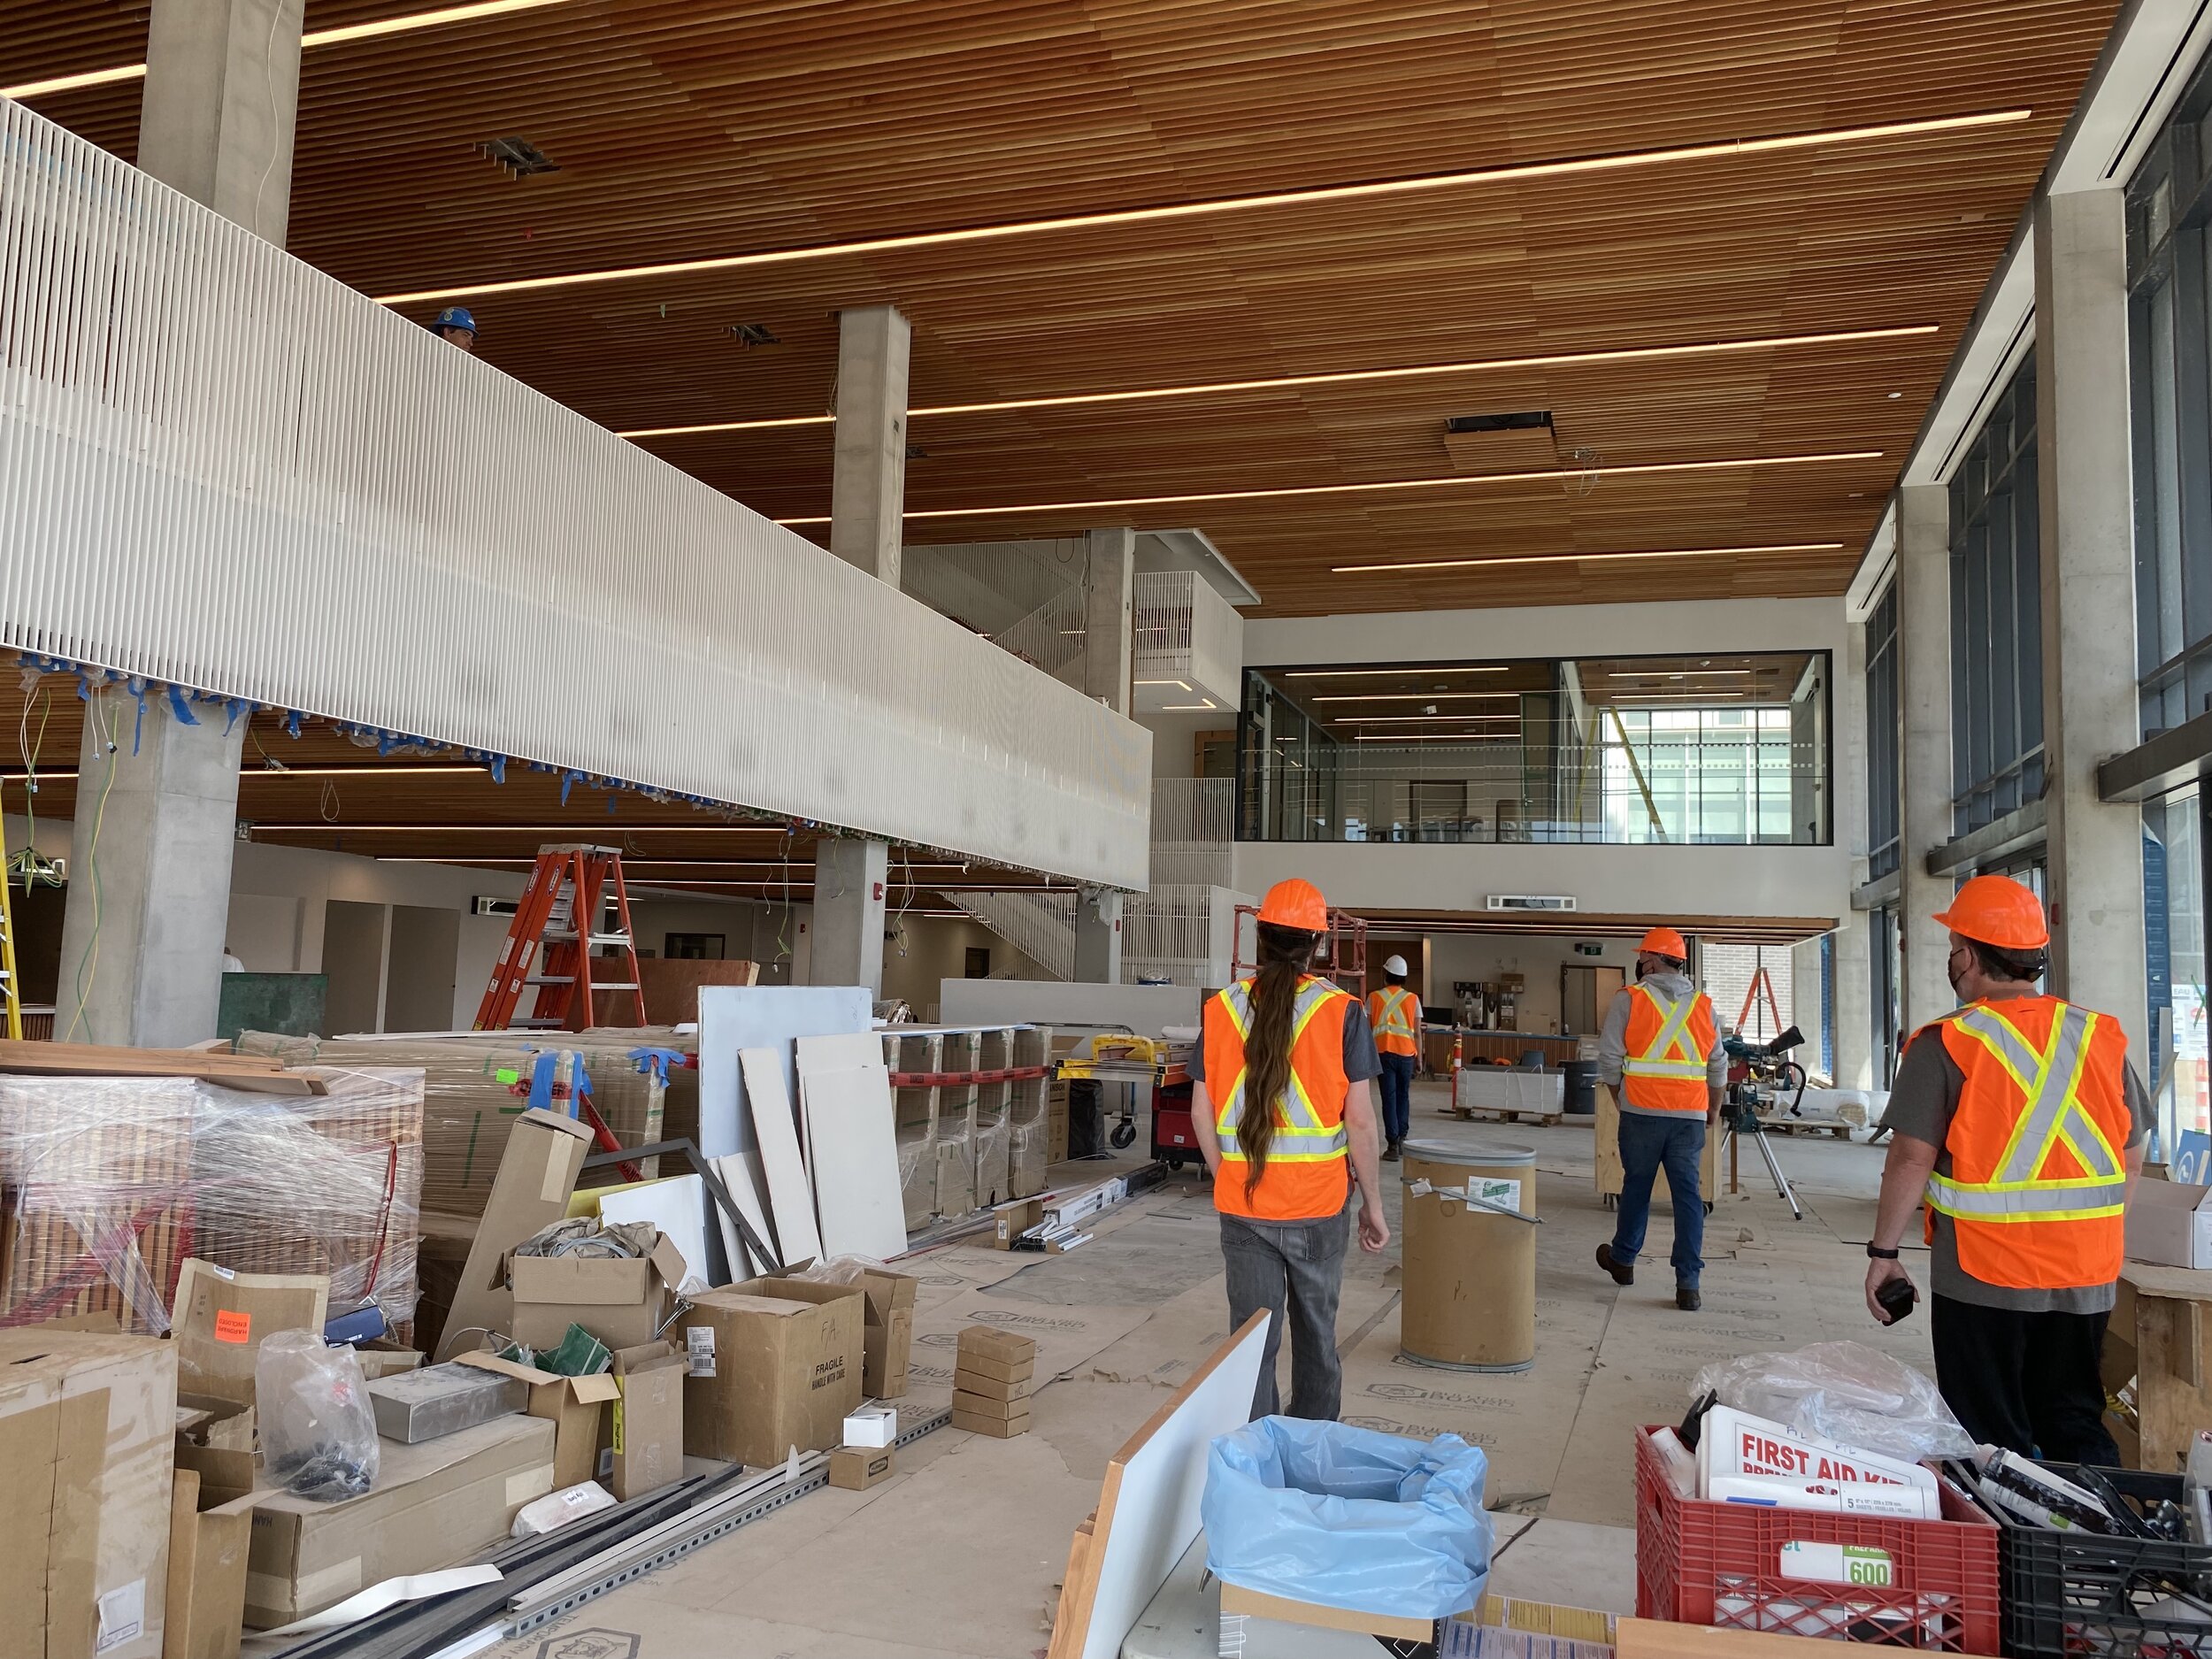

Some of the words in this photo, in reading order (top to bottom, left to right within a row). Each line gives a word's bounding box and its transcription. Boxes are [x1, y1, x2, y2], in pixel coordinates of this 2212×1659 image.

[816, 1356, 843, 1376] FRAGILE
[811, 1375, 826, 1391] HANDLE
[826, 1371, 836, 1386] WITH
[836, 1368, 846, 1382] CARE
[1742, 1432, 1809, 1475] FIRST
[1816, 1457, 1857, 1483] AID
[1847, 1498, 1855, 1509] 5
[252, 1514, 273, 1528] HAN
[1849, 1560, 1888, 1586] 600
